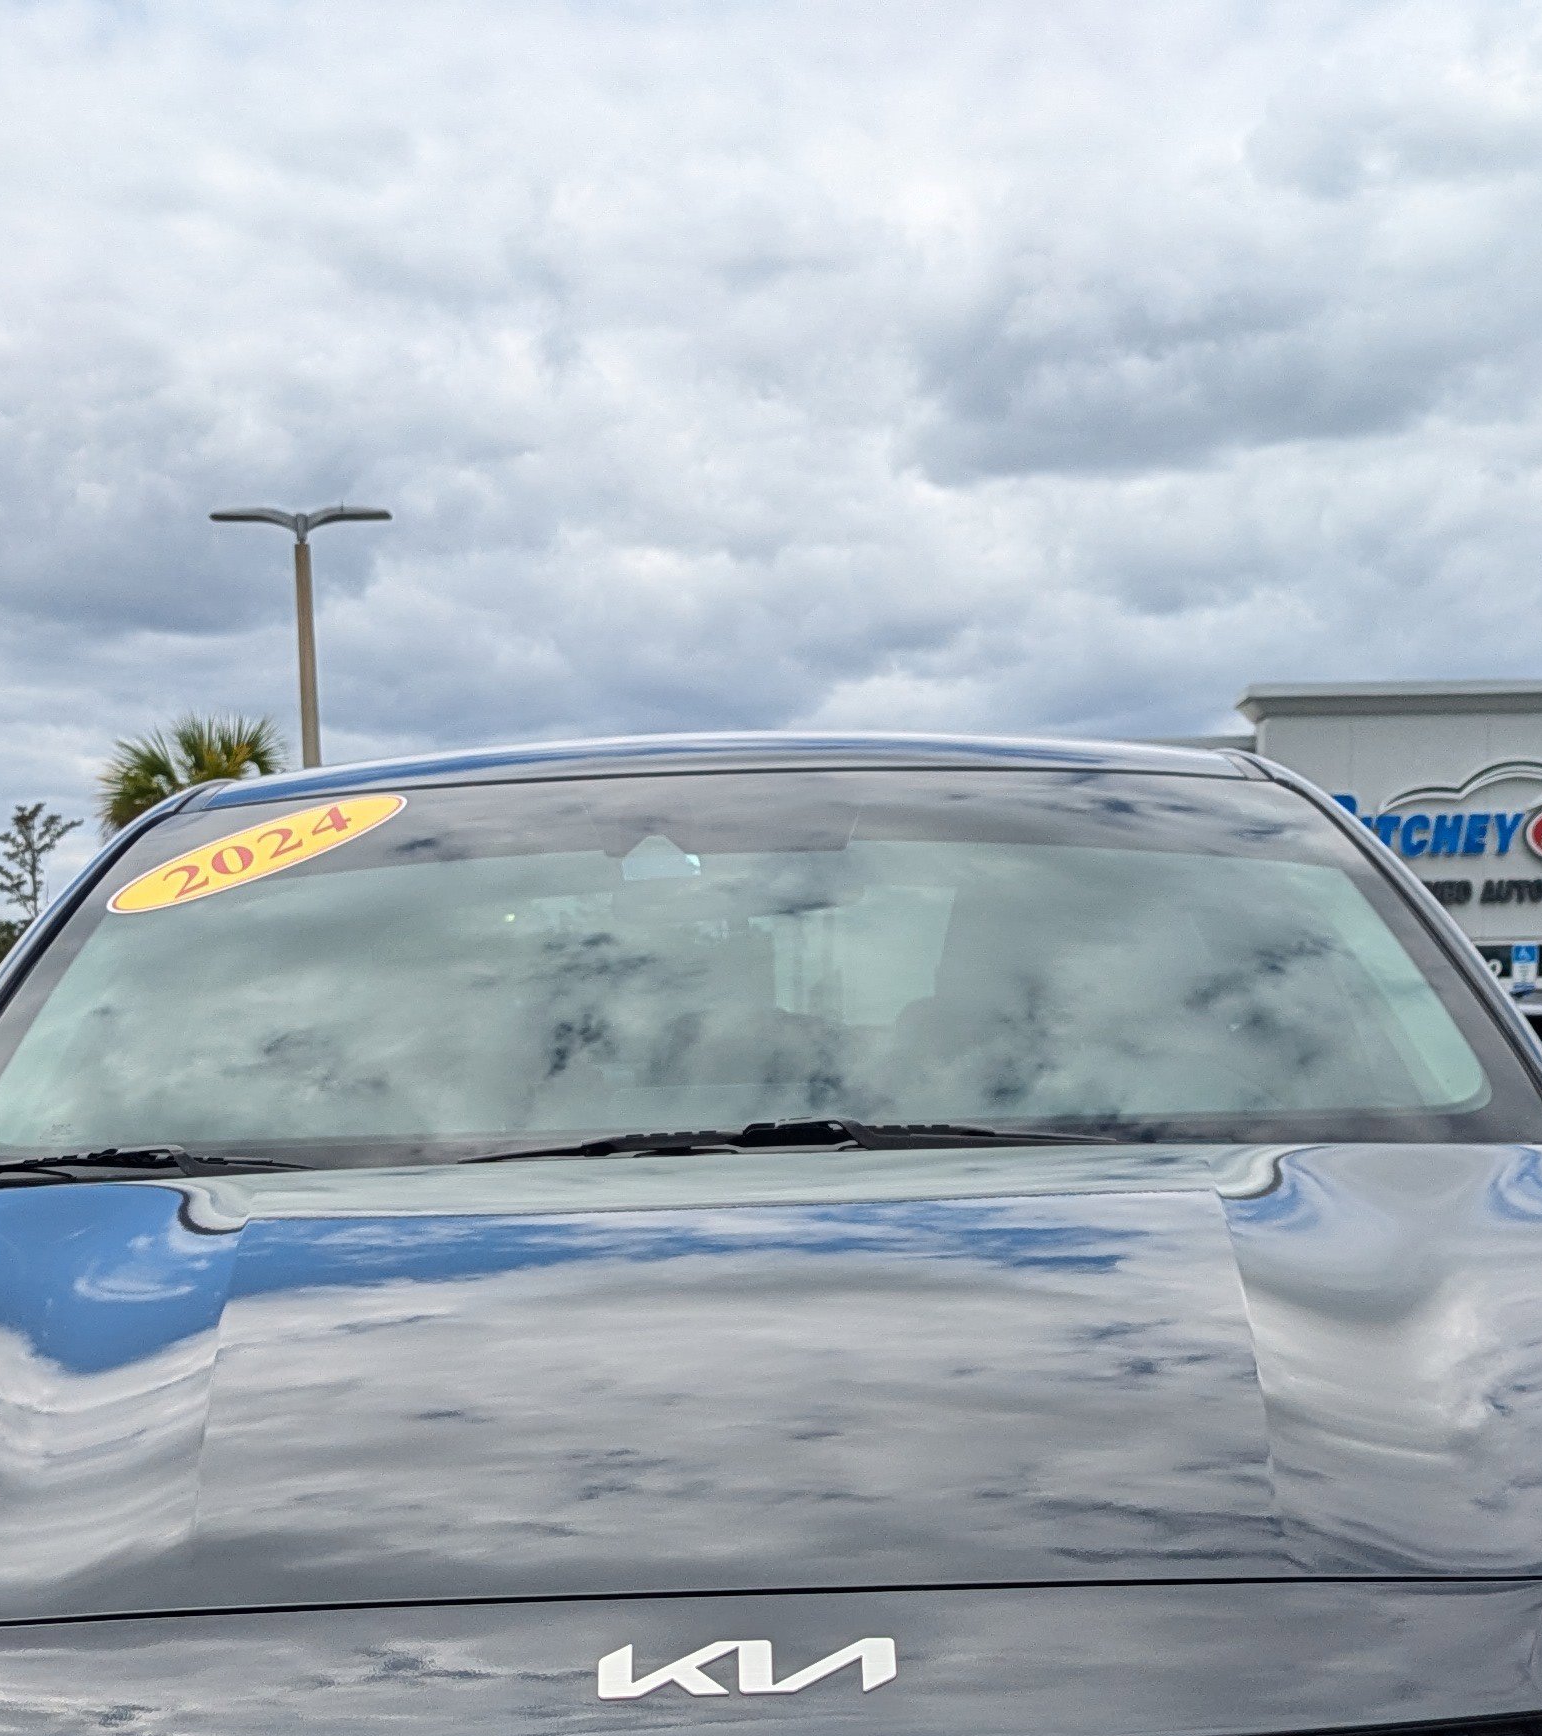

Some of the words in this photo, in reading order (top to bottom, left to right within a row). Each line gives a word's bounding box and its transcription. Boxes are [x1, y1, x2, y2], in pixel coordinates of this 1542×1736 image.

[162, 806, 352, 899] 2024
[1332, 794, 1526, 857] TCHEY
[597, 1637, 898, 1701] KIA
